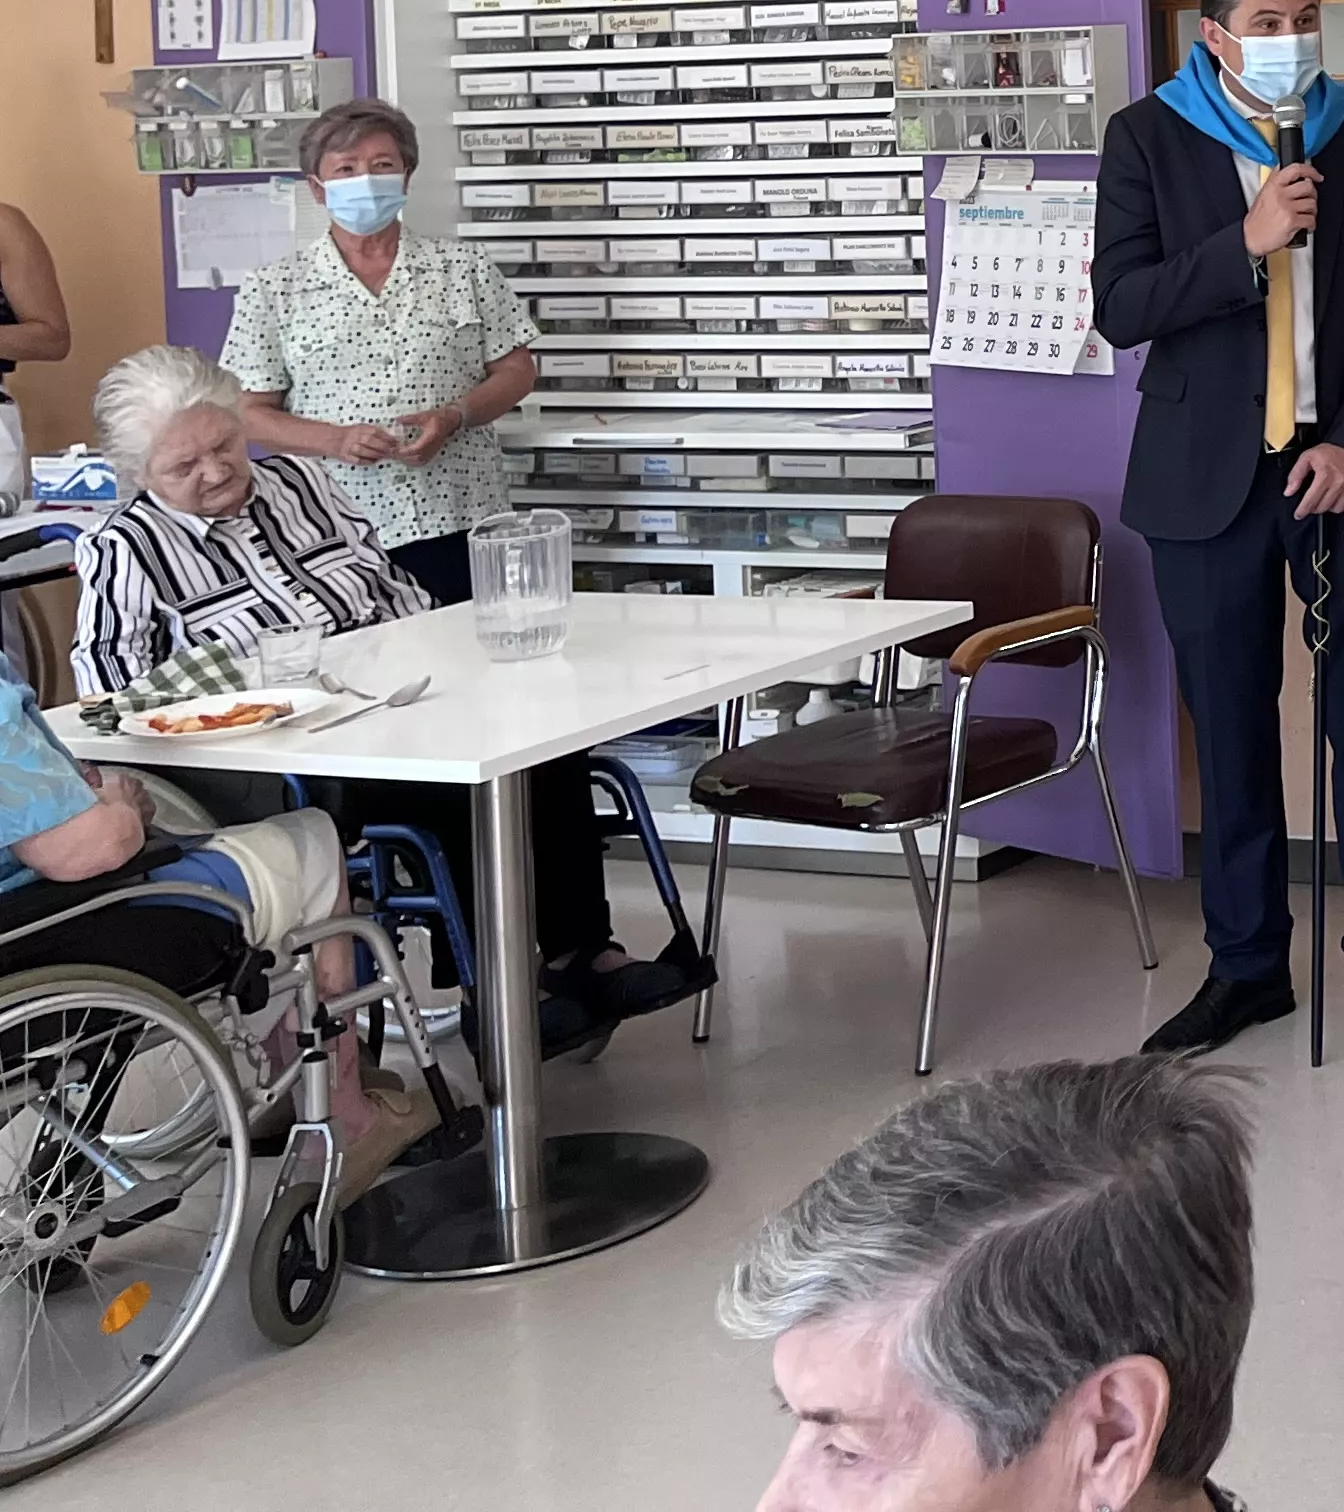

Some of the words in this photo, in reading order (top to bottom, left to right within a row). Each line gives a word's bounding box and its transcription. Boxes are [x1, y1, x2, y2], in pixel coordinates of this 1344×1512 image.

[959, 206, 1024, 221] septiembre
[1037, 231, 1043, 245] 1
[1060, 232, 1066, 246] 2
[1082, 233, 1089, 247] 3
[951, 255, 957, 269] 4
[971, 256, 978, 270] 5
[993, 257, 999, 271] 6
[1015, 258, 1022, 272] 7
[1037, 258, 1043, 273] 8
[1058, 260, 1065, 274] 9
[1081, 260, 1091, 275] 10
[970, 283, 978, 298] 12
[991, 284, 999, 299] 13
[1012, 285, 1021, 299] 14
[1034, 286, 1044, 300] 15
[1055, 287, 1065, 302] 16
[1077, 289, 1087, 303] 17
[946, 309, 955, 323] 18
[967, 310, 976, 324] 19
[987, 311, 999, 326] 20
[1009, 313, 1018, 327] 21
[1031, 314, 1042, 328] 22
[1052, 315, 1063, 329] 23
[1074, 317, 1084, 331] 24
[940, 336, 952, 350] 25
[962, 337, 974, 351] 26
[983, 339, 996, 353] 27
[1005, 340, 1017, 354] 28
[1027, 342, 1039, 356] 29
[1048, 343, 1060, 358] 30
[1086, 344, 1098, 358] 29
